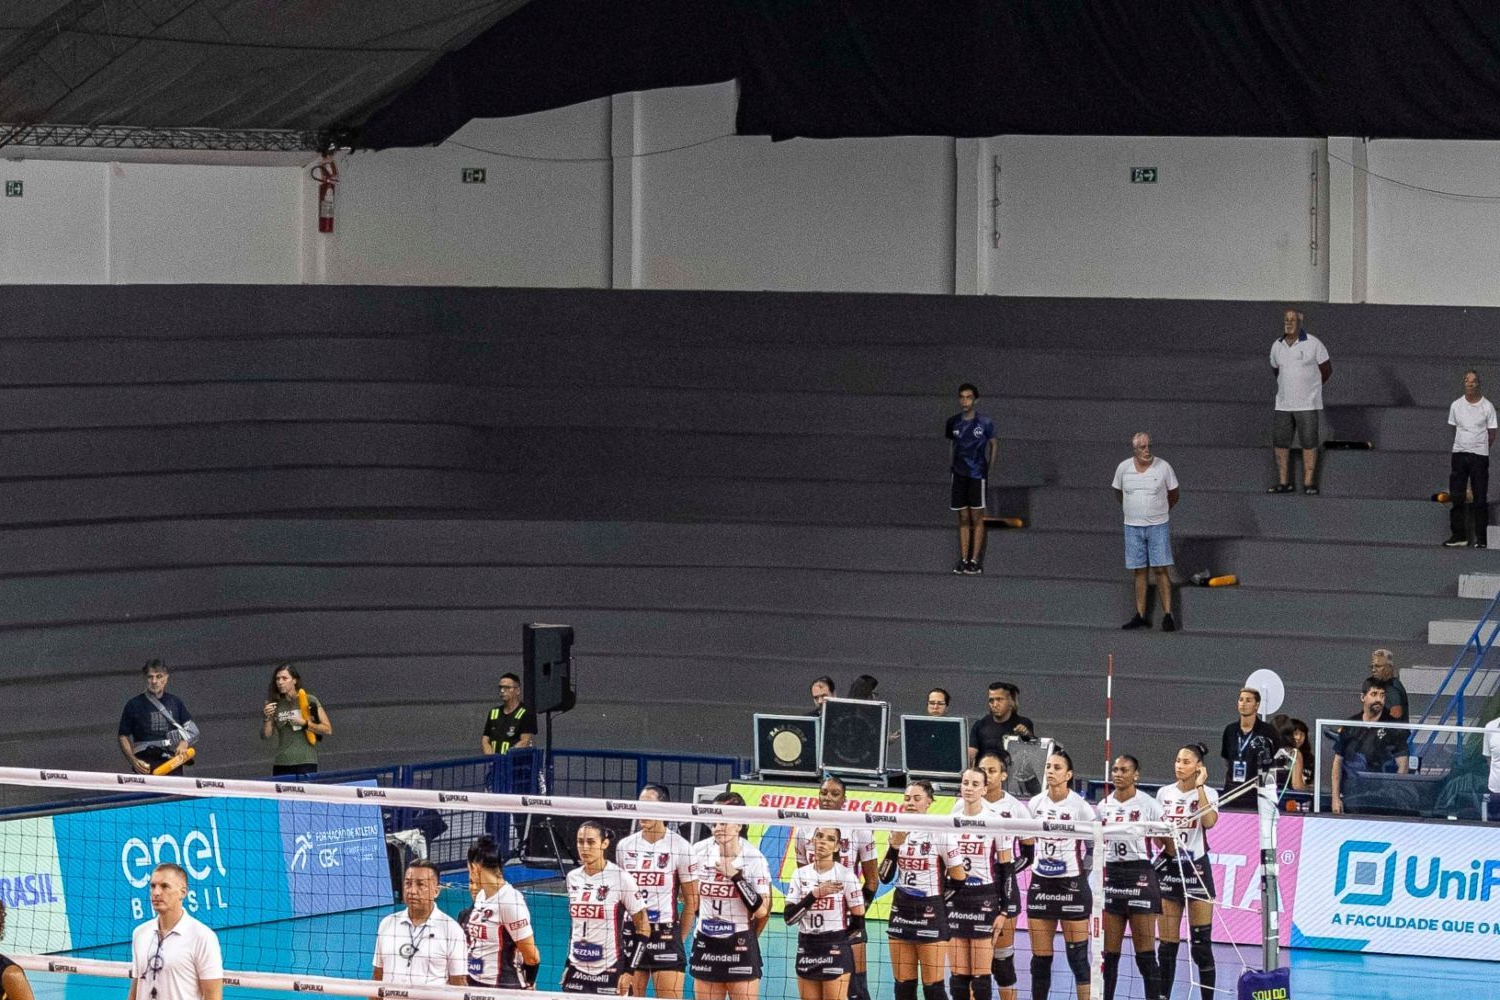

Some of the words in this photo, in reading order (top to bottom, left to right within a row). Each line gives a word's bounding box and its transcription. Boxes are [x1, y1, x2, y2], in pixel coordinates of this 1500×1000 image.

[528, 798, 551, 806] SUPERLIGA
[613, 802, 636, 811] SUPERLIGA
[699, 806, 722, 816] SUPERLIGA
[785, 810, 809, 819] SUPERLIGA
[872, 815, 897, 824] SUPERLIGA
[961, 819, 986, 828] SUPERLIGA
[355, 825, 379, 837] ATLETAS
[1050, 823, 1076, 832] SUPERLIGA
[121, 812, 227, 889] enel
[1113, 842, 1128, 857] 18
[632, 873, 662, 886] SESI
[904, 872, 917, 886] 12
[700, 884, 735, 898] SESI
[132, 886, 229, 921] BSIL
[1035, 893, 1074, 902] Mondelli
[570, 904, 600, 918] SESI
[712, 900, 723, 915] 4
[810, 913, 824, 929] 10
[948, 911, 986, 921] Mondelli
[1331, 913, 1342, 925] A
[1346, 913, 1439, 931] FACULDADE
[1441, 919, 1475, 934] QUE
[1477, 922, 1491, 934] O
[701, 953, 741, 963] Mondelli
[385, 990, 408, 998] SUPERLIGA
[1272, 987, 1287, 1000] DO
